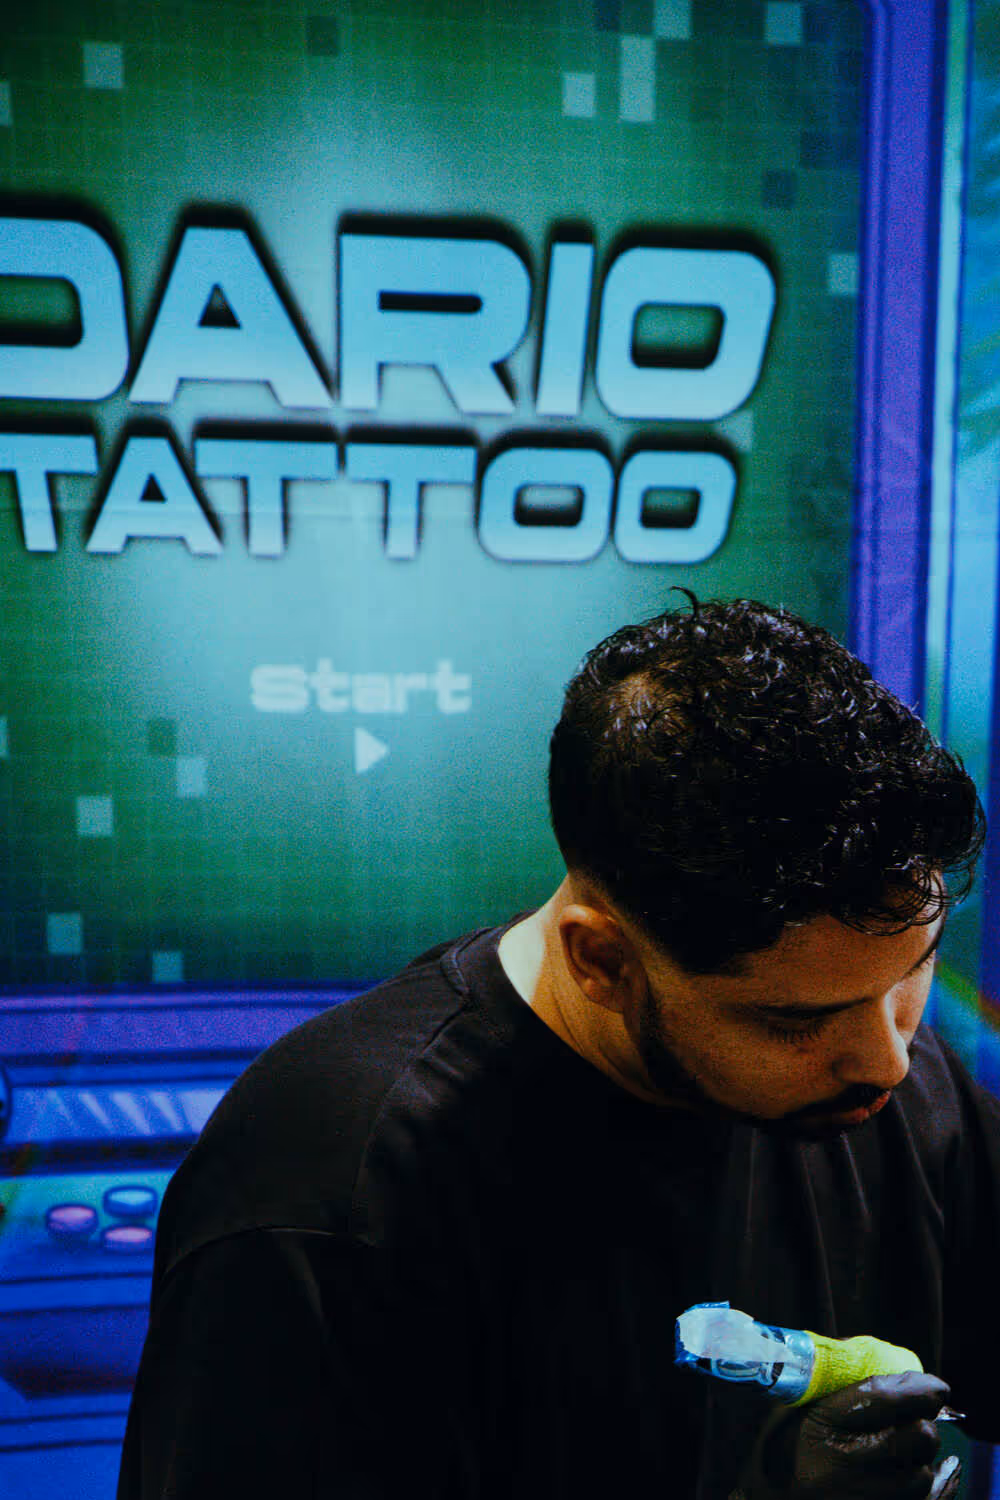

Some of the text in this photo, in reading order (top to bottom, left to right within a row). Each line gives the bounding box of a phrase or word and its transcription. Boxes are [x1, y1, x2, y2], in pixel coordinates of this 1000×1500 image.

[0, 212, 777, 421] DARIO
[0, 426, 738, 564] TATTOO
[250, 657, 472, 714] Start
